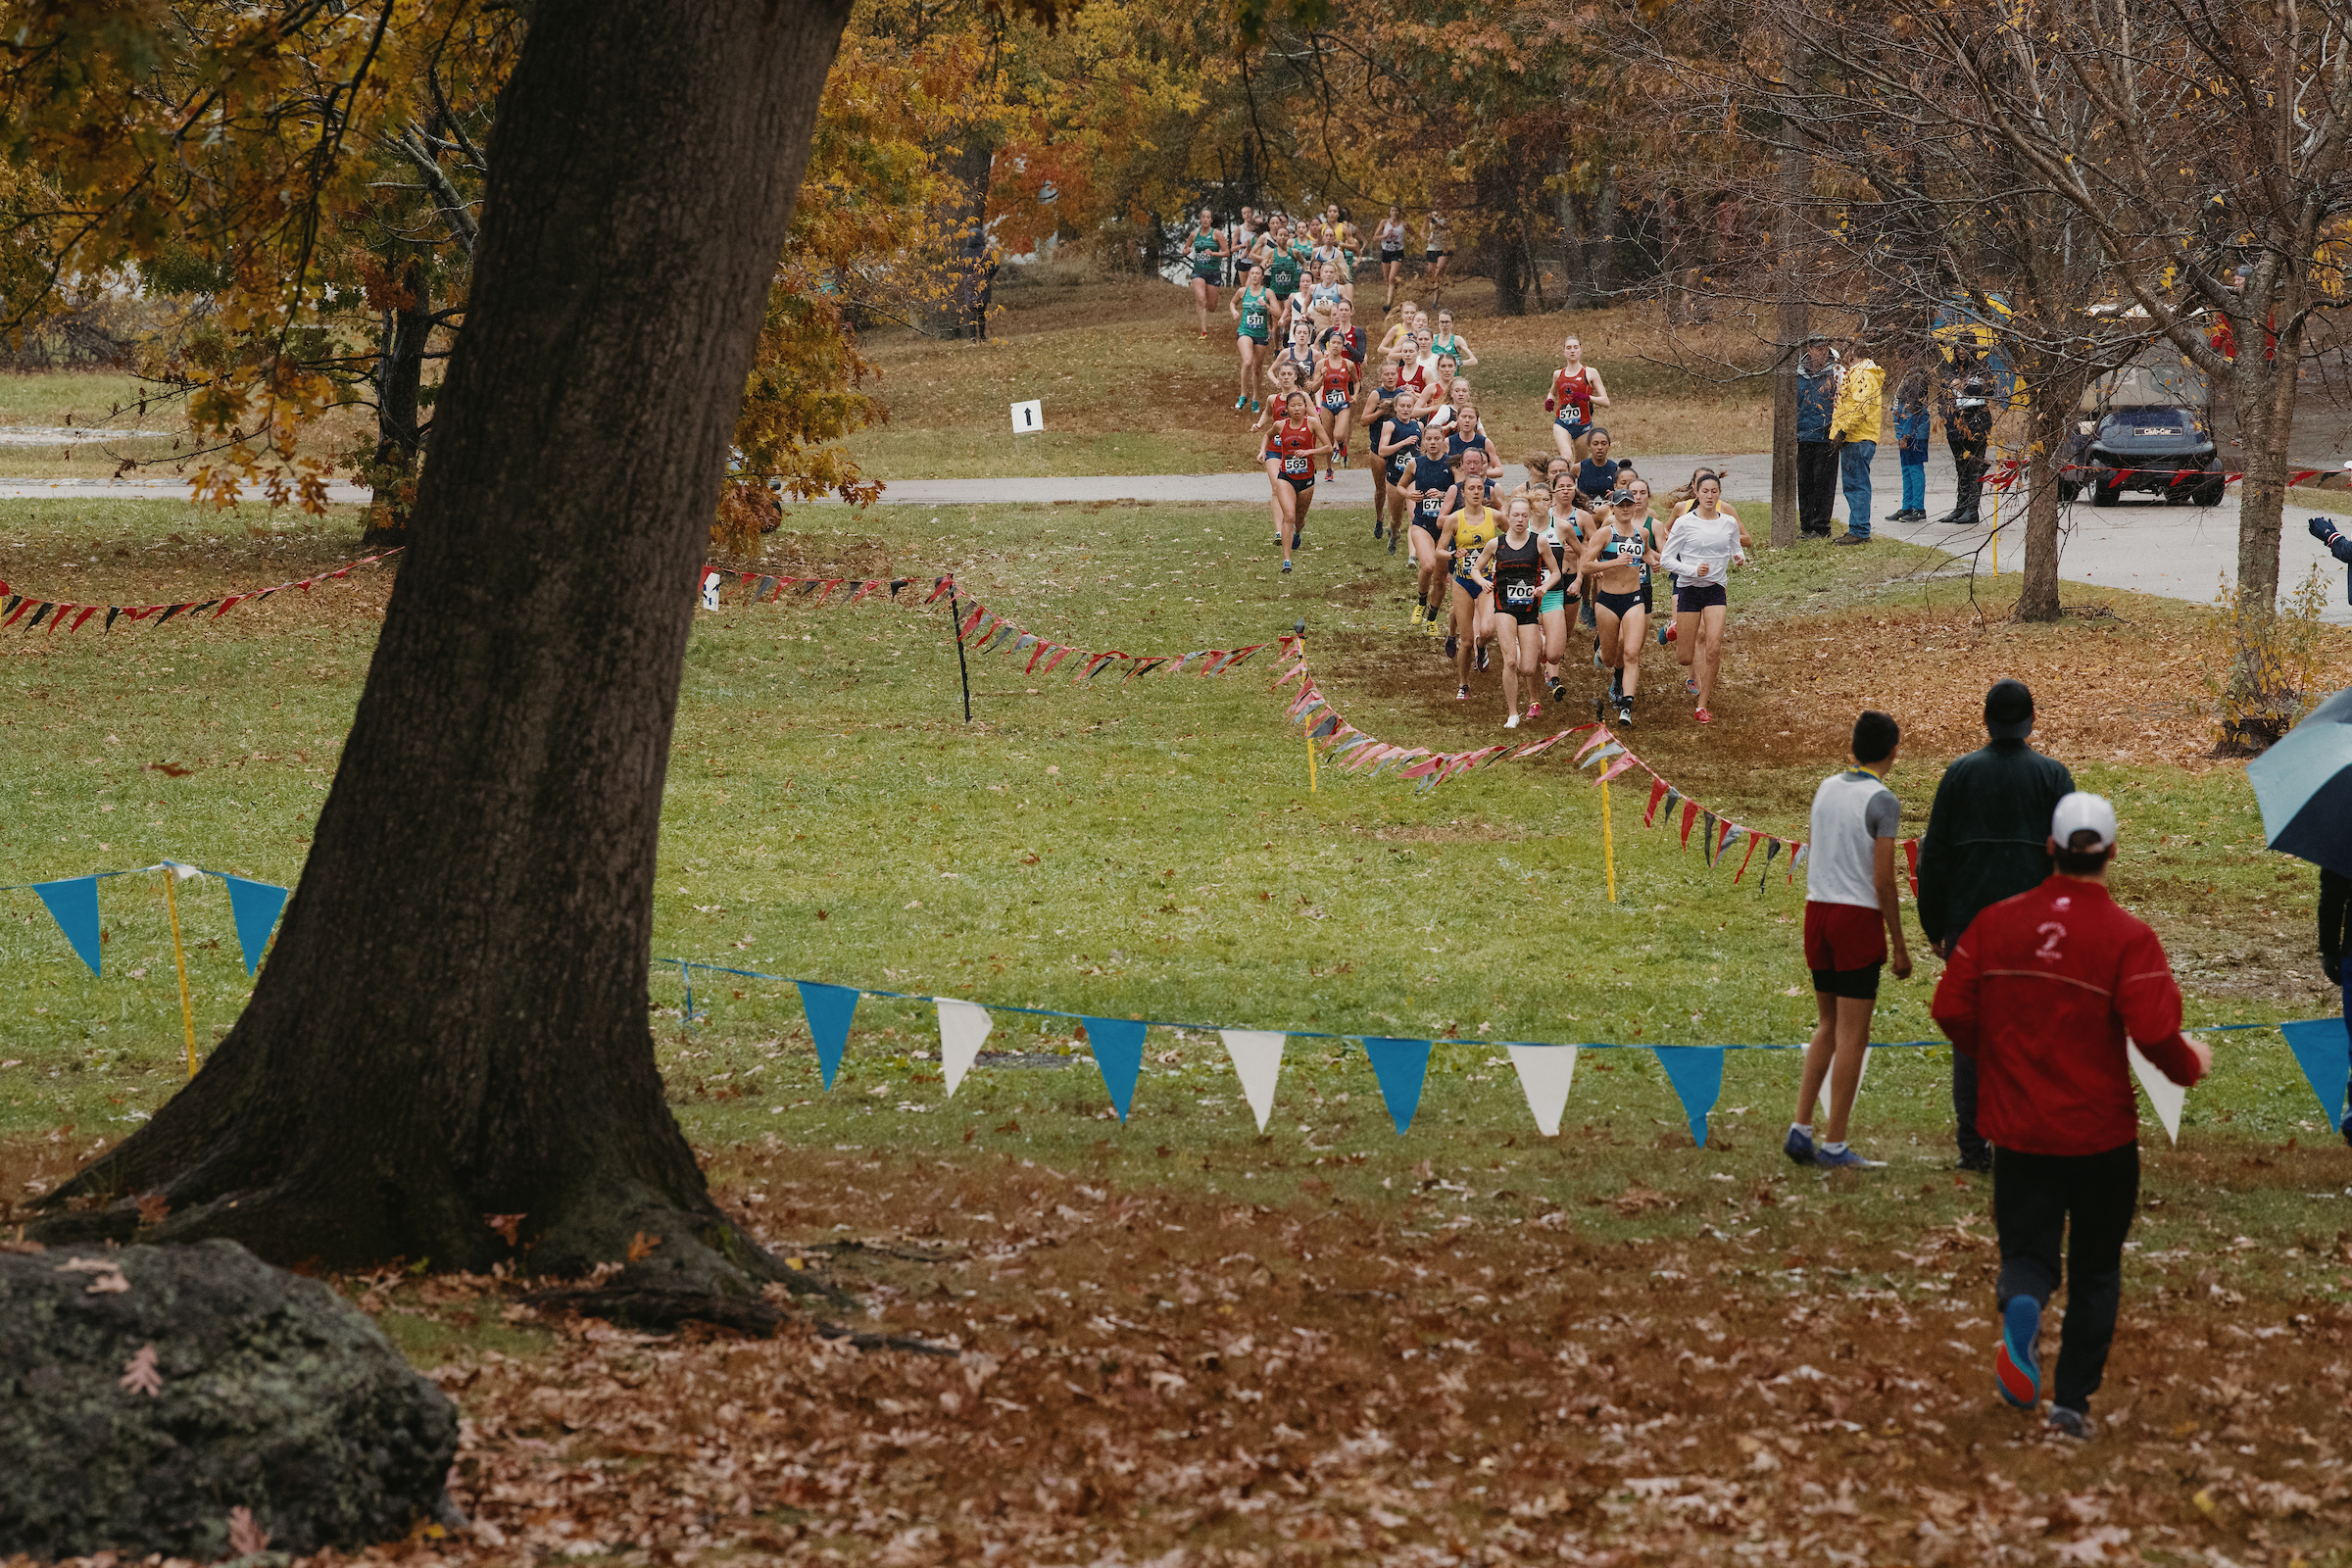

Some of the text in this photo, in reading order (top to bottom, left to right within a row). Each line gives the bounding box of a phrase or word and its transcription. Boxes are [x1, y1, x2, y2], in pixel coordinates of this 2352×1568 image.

[1327, 393, 1345, 404] 571
[1560, 409, 1580, 419] 570
[1286, 460, 1306, 469] 569
[1618, 545, 1642, 556] 640
[1508, 587, 1534, 597] 700
